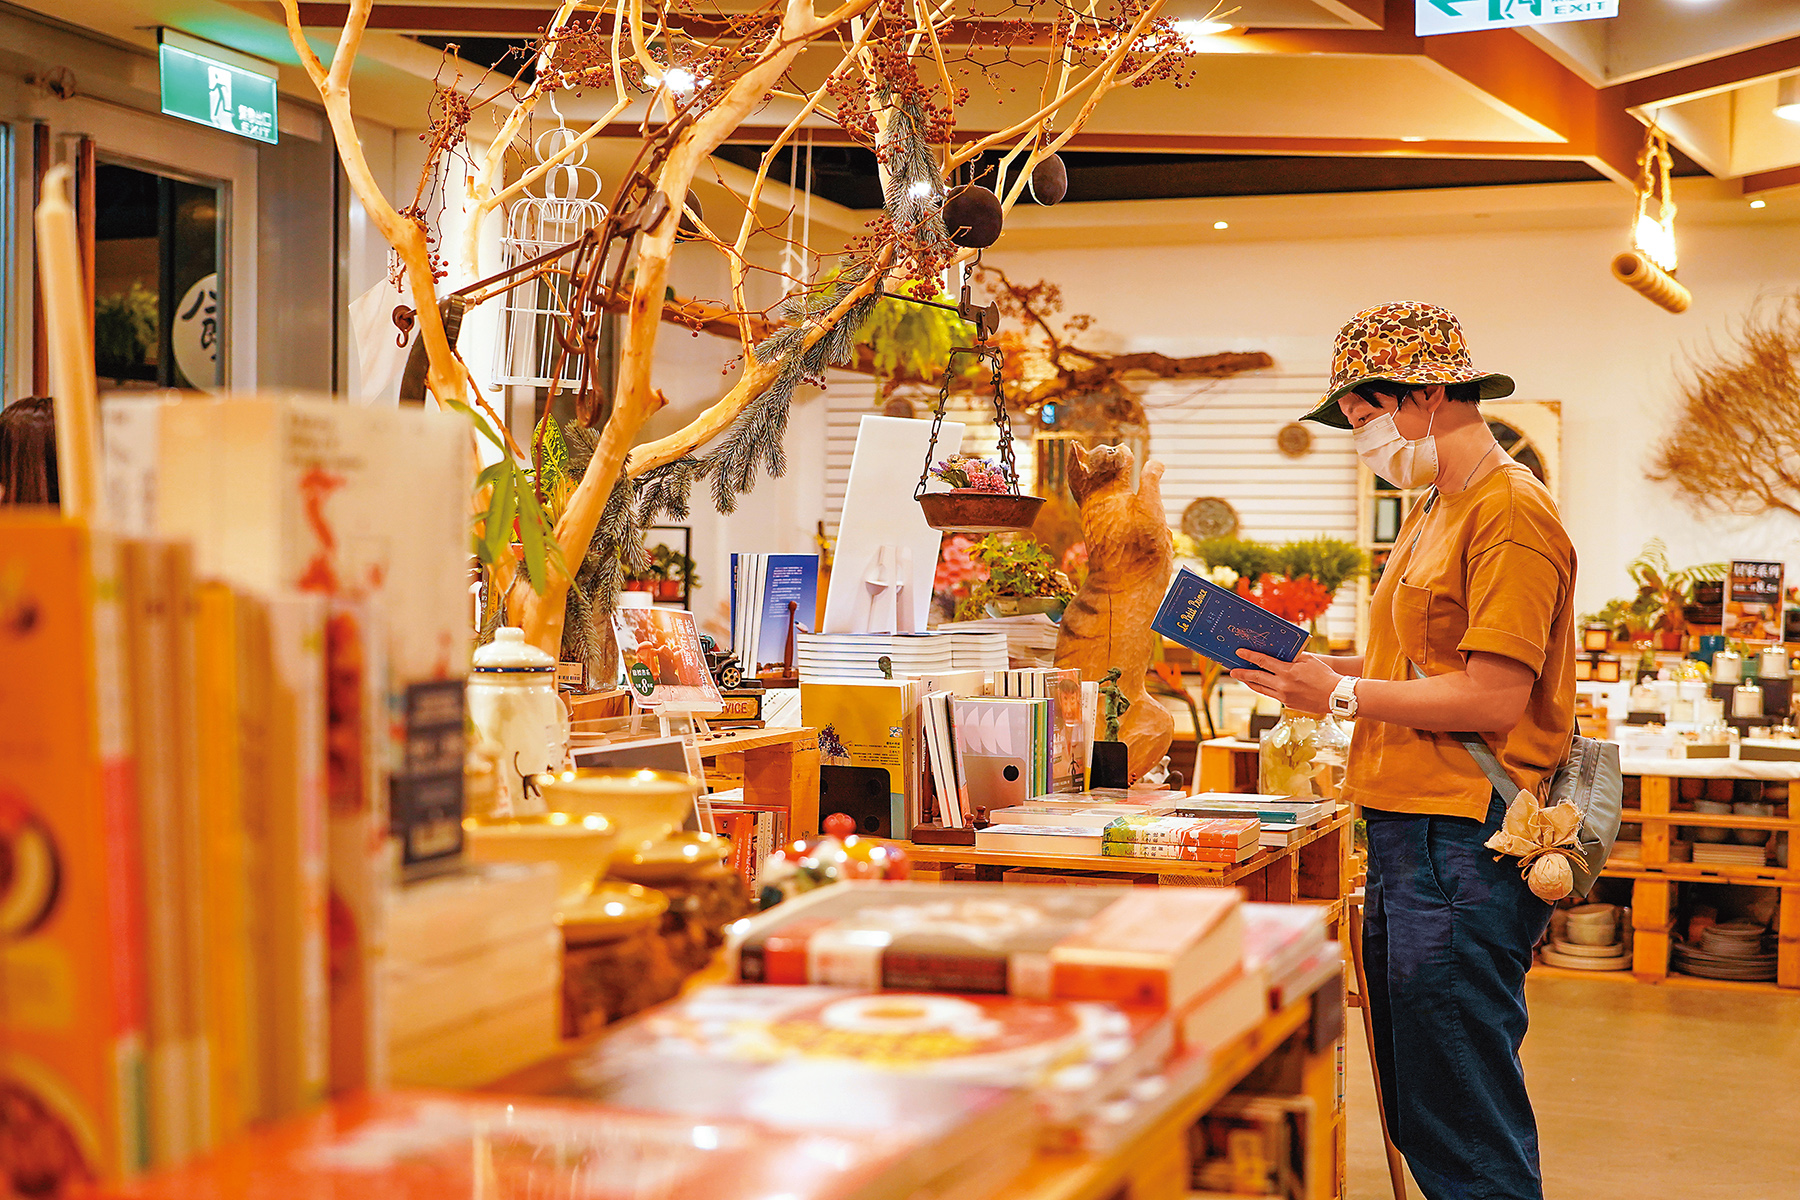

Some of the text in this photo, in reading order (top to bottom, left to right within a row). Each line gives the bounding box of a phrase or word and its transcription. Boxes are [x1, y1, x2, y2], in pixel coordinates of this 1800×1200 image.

[1554, 2, 1605, 15] EXIT
[241, 121, 272, 137] EXIT
[1176, 589, 1208, 633] Le Petit Prince
